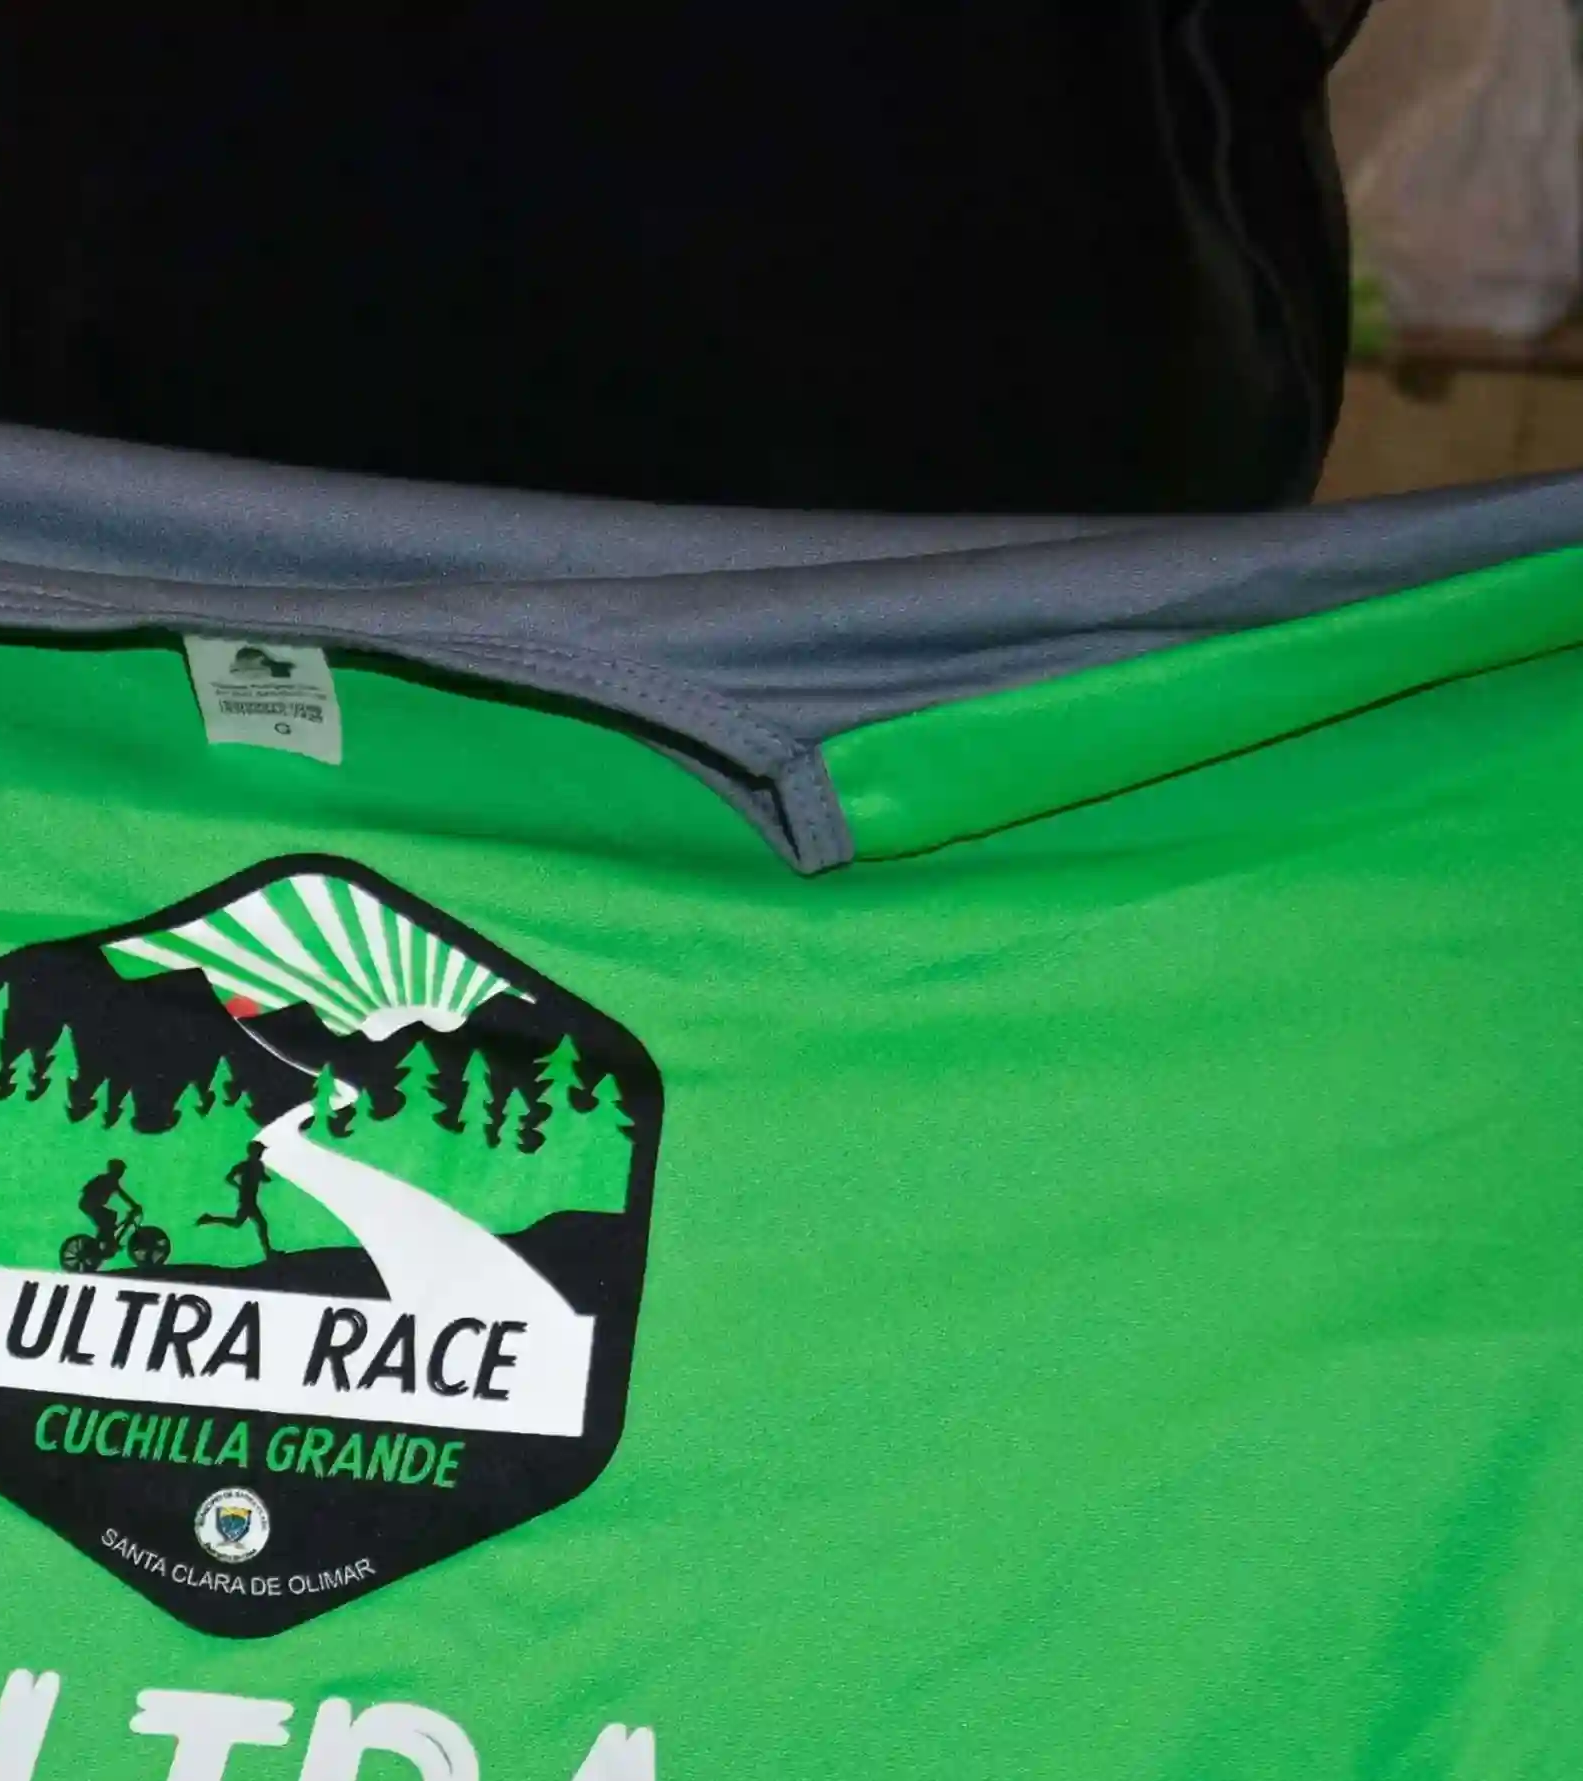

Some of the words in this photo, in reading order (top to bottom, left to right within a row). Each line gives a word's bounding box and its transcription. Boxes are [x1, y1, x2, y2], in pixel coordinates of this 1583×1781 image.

[7, 1281, 262, 1381] ULTRA
[304, 1308, 528, 1401] RACE
[35, 1404, 251, 1469] CUCHILLA
[266, 1424, 467, 1489] GRANDE
[100, 1527, 168, 1578] SANTA
[171, 1562, 247, 1596] CLARA
[250, 1576, 282, 1597] DE
[288, 1556, 377, 1597] OLIMAR
